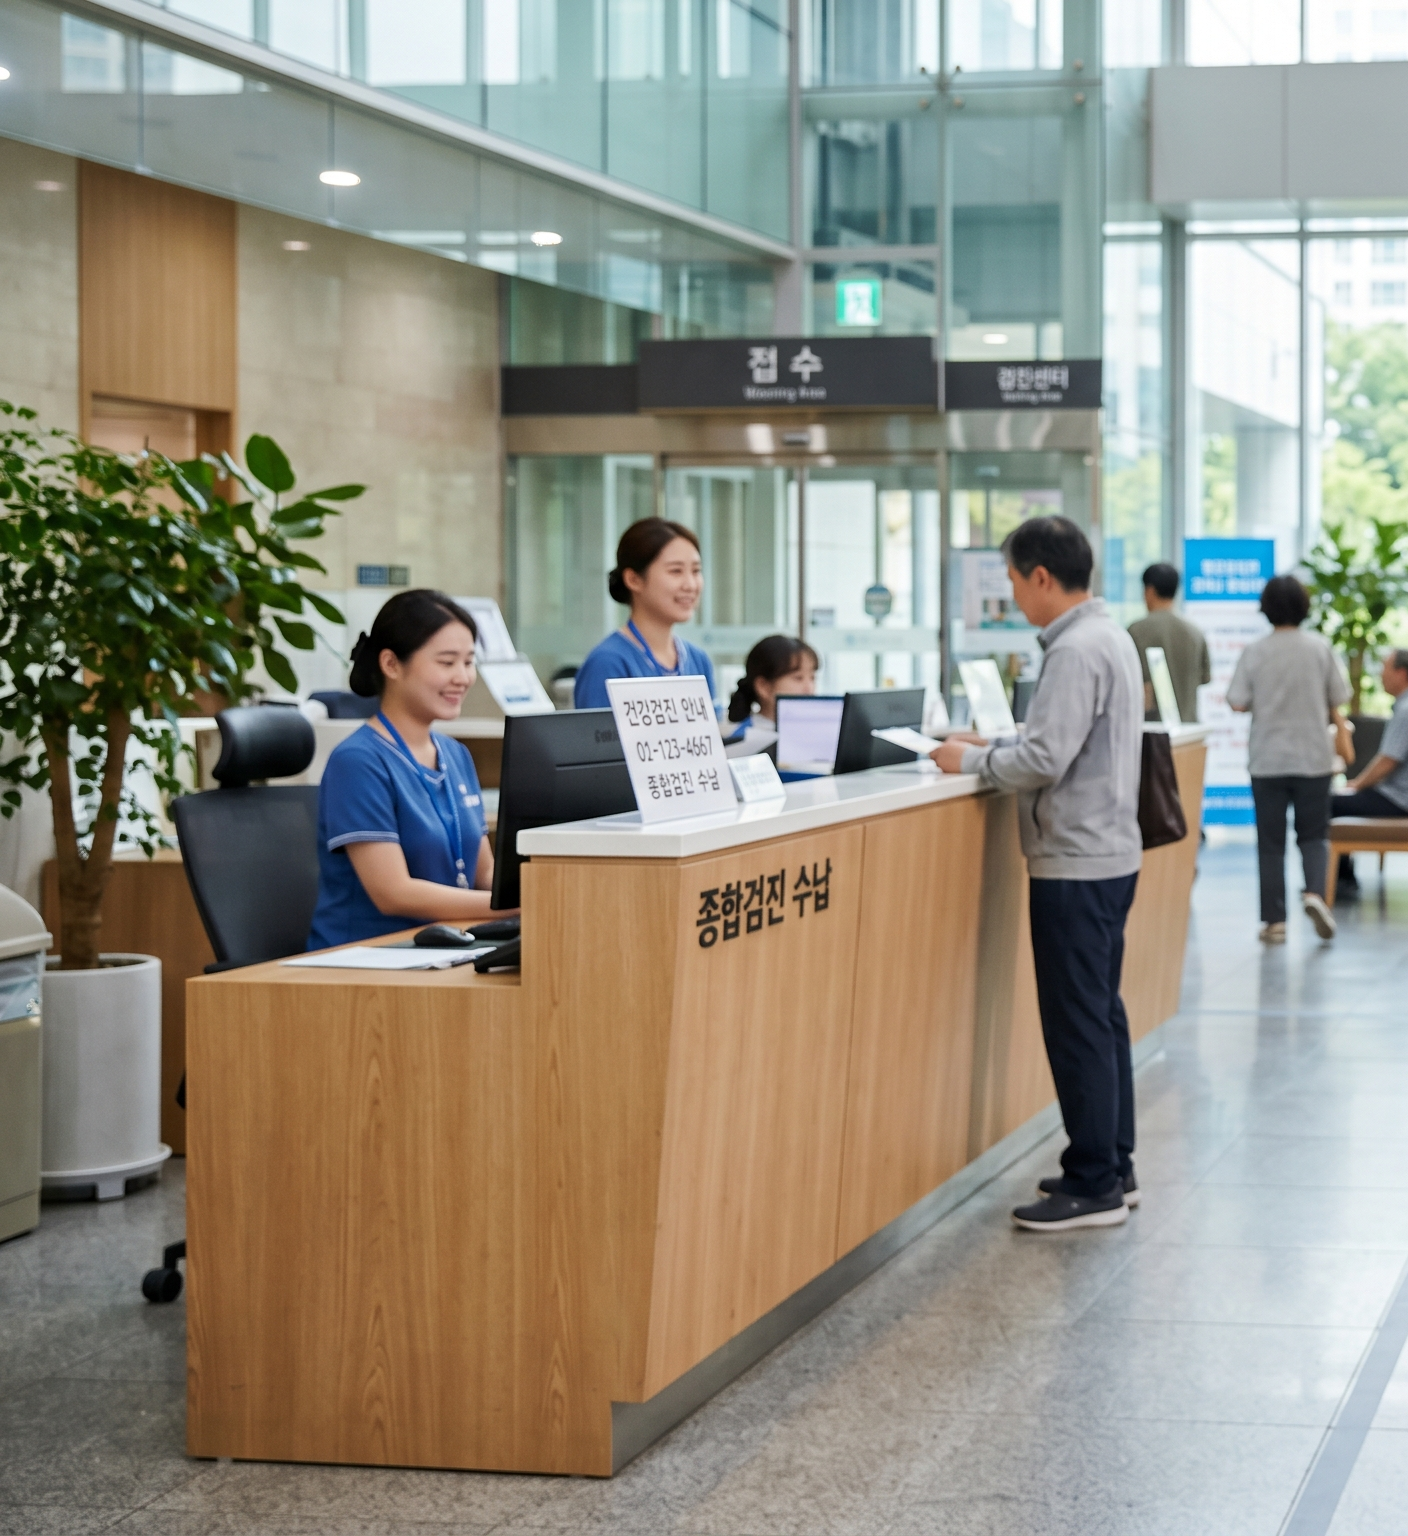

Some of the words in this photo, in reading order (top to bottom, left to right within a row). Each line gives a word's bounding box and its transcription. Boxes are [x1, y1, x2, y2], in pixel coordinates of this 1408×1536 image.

[623, 697, 679, 727] 건강검진
[680, 696, 709, 723] 안내
[647, 770, 695, 800] 종합검진
[696, 868, 786, 949] 종합검진
[792, 857, 833, 918] 수납
